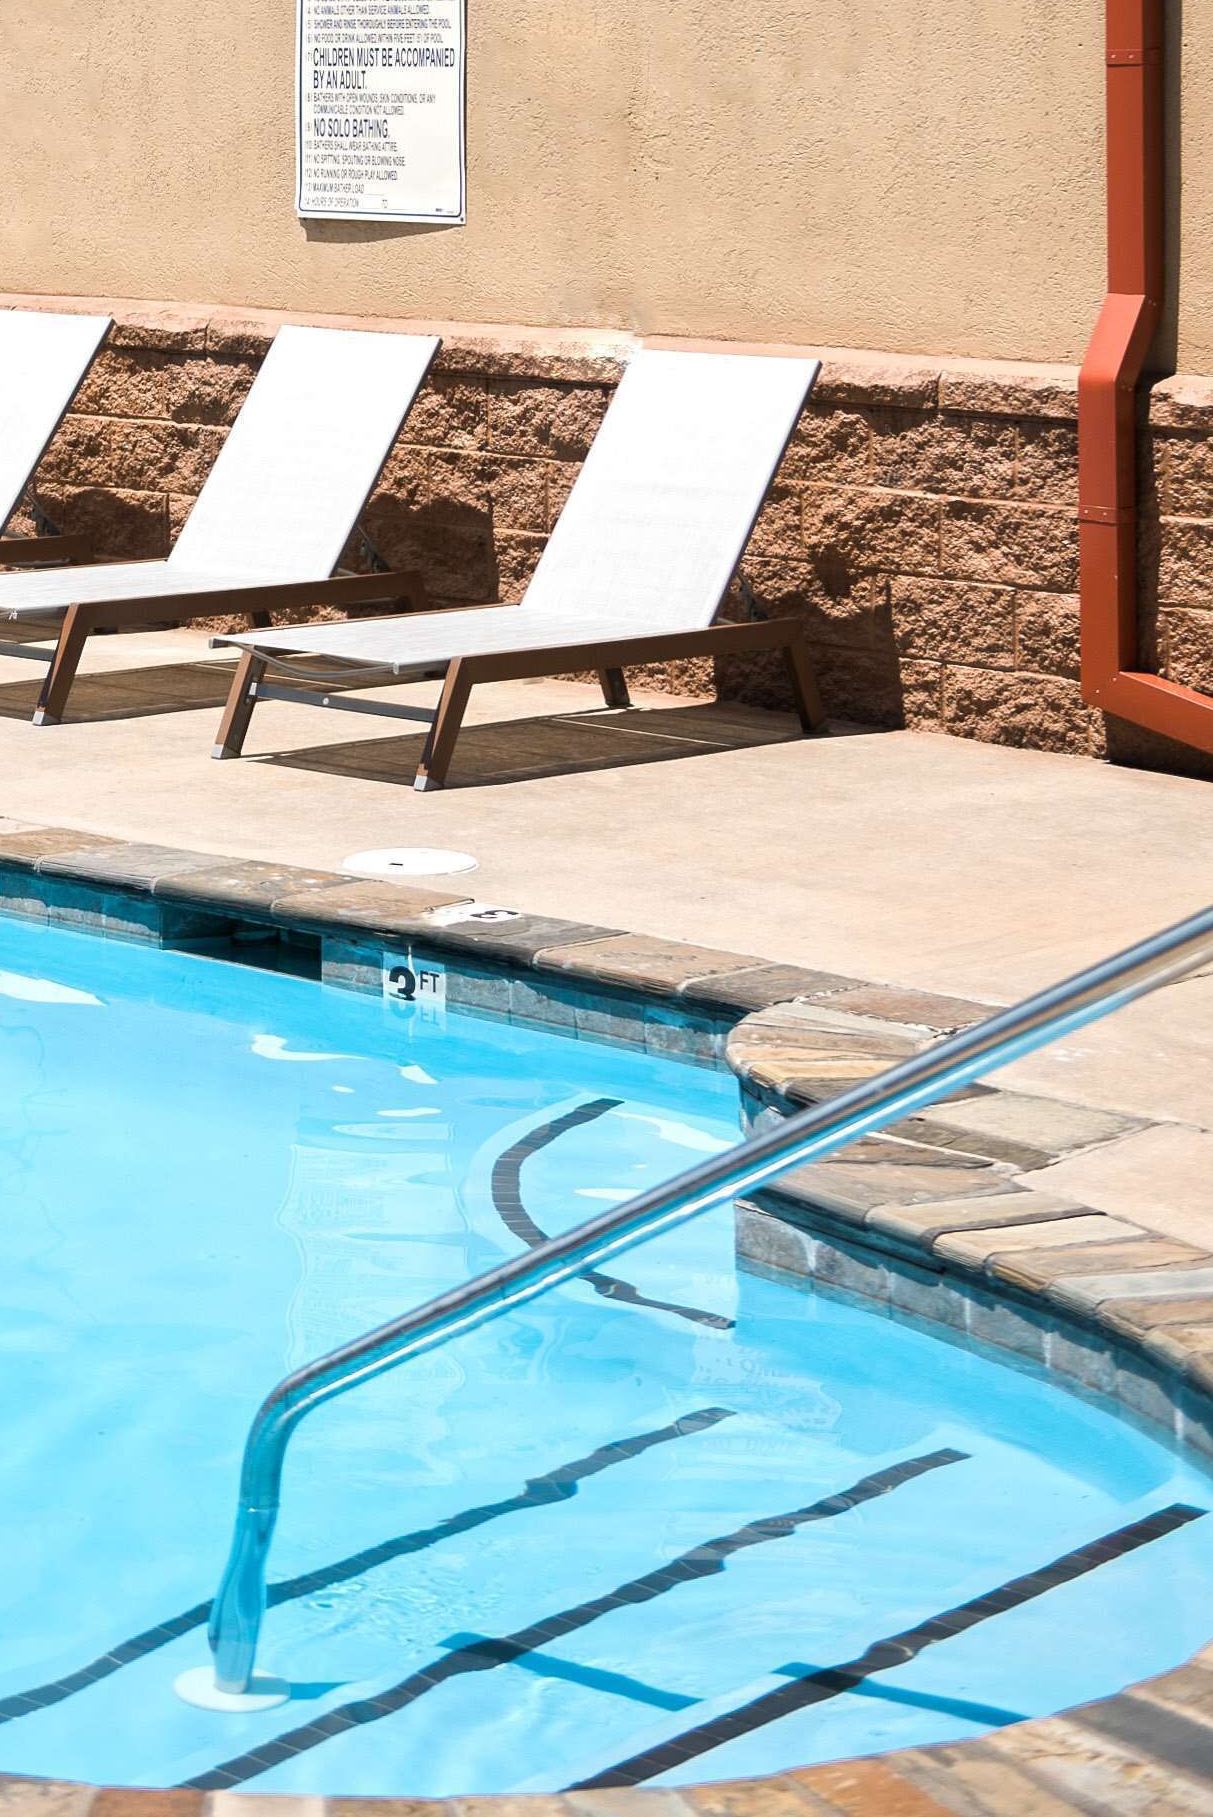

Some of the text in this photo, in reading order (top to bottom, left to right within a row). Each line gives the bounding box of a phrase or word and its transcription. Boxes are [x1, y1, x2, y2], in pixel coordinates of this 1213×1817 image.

[313, 47, 355, 67] CHILDREN
[356, 47, 380, 67] MUST
[381, 47, 393, 67] BE
[394, 47, 455, 68] ACCOMPANIED
[313, 69, 325, 89] BY
[326, 69, 338, 89] AN
[313, 118, 325, 137] NO
[327, 118, 350, 137] SOLO
[419, 969, 440, 993] FT
